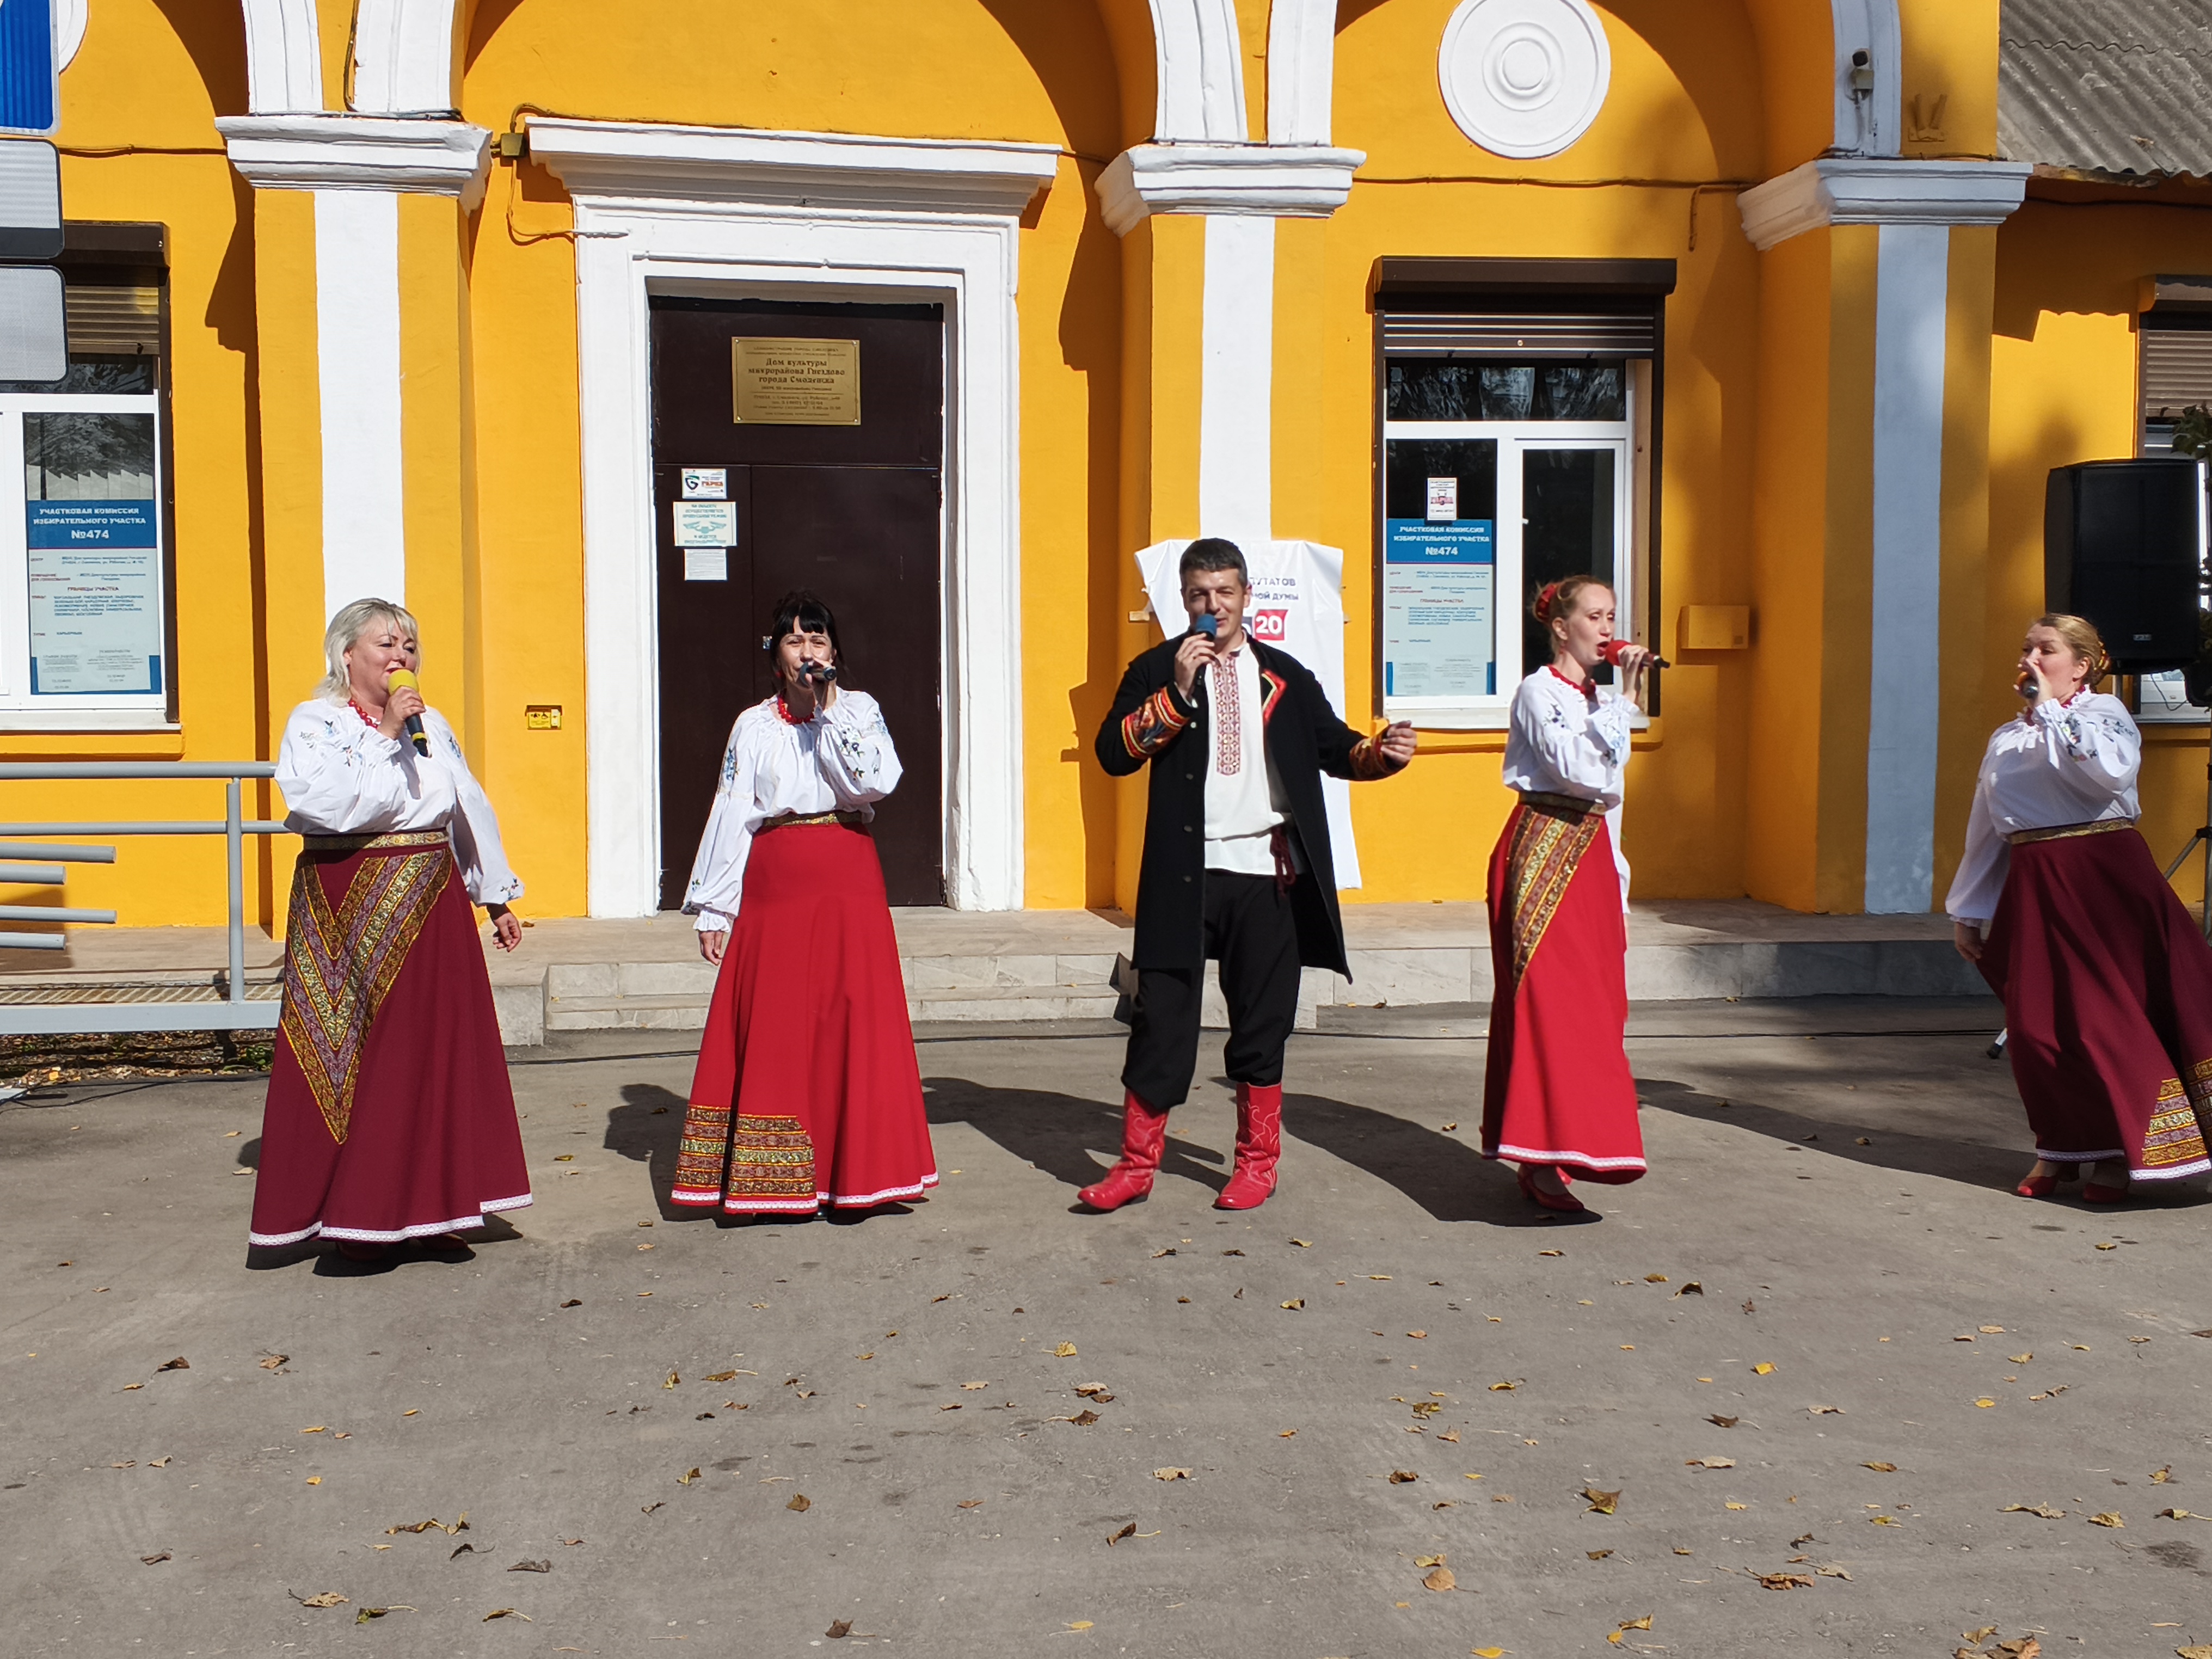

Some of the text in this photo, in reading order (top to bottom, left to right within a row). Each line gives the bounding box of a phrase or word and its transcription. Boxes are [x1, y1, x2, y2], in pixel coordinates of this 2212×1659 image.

[766, 358, 784, 366] Дом
[748, 367, 804, 375] микрорайона
[790, 376, 834, 384] Смоленска
[71, 530, 109, 539] №474
[1425, 546, 1458, 555] №474
[1249, 577, 1297, 586] ПУТАТОВ
[1256, 615, 1282, 636] 20
